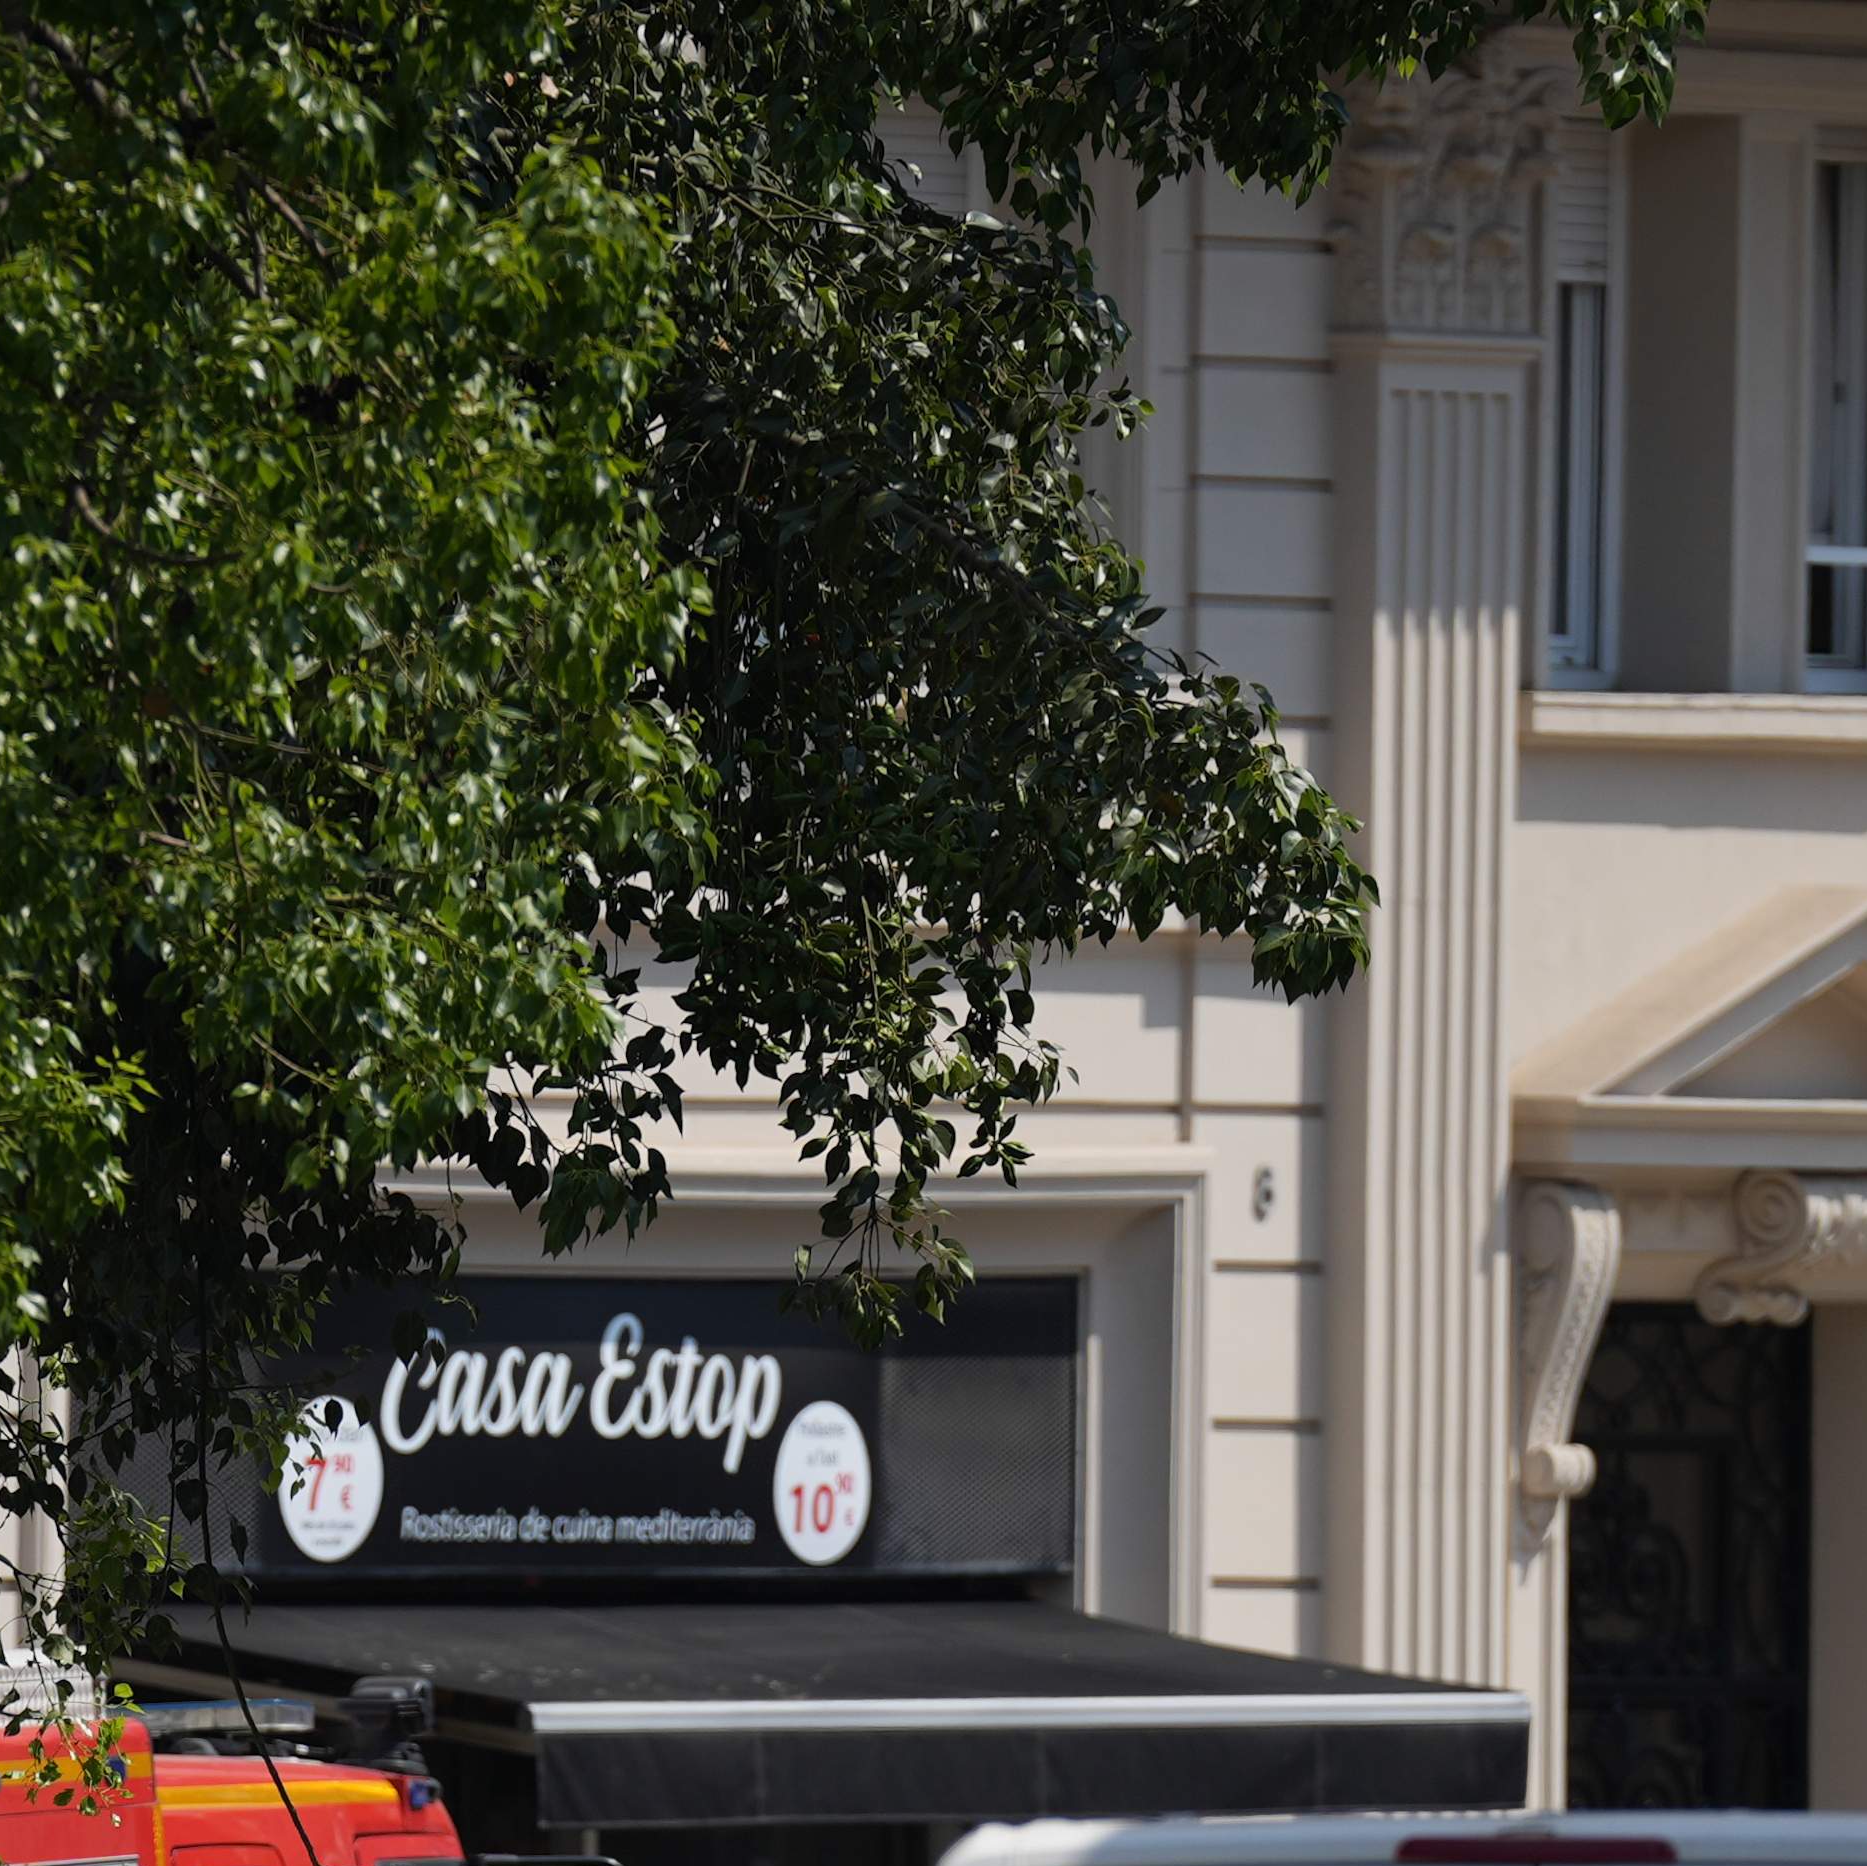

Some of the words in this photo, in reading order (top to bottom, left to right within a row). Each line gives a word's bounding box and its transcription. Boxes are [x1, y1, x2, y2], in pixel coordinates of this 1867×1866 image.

[381, 1327, 584, 1454] Casa
[590, 1312, 782, 1474] Estop
[305, 1456, 328, 1511] 7
[791, 1483, 834, 1533] 10
[400, 1504, 518, 1541] Rostisseria
[519, 1506, 551, 1542] de
[552, 1507, 614, 1542] cuina
[615, 1506, 756, 1543] mediterrània
